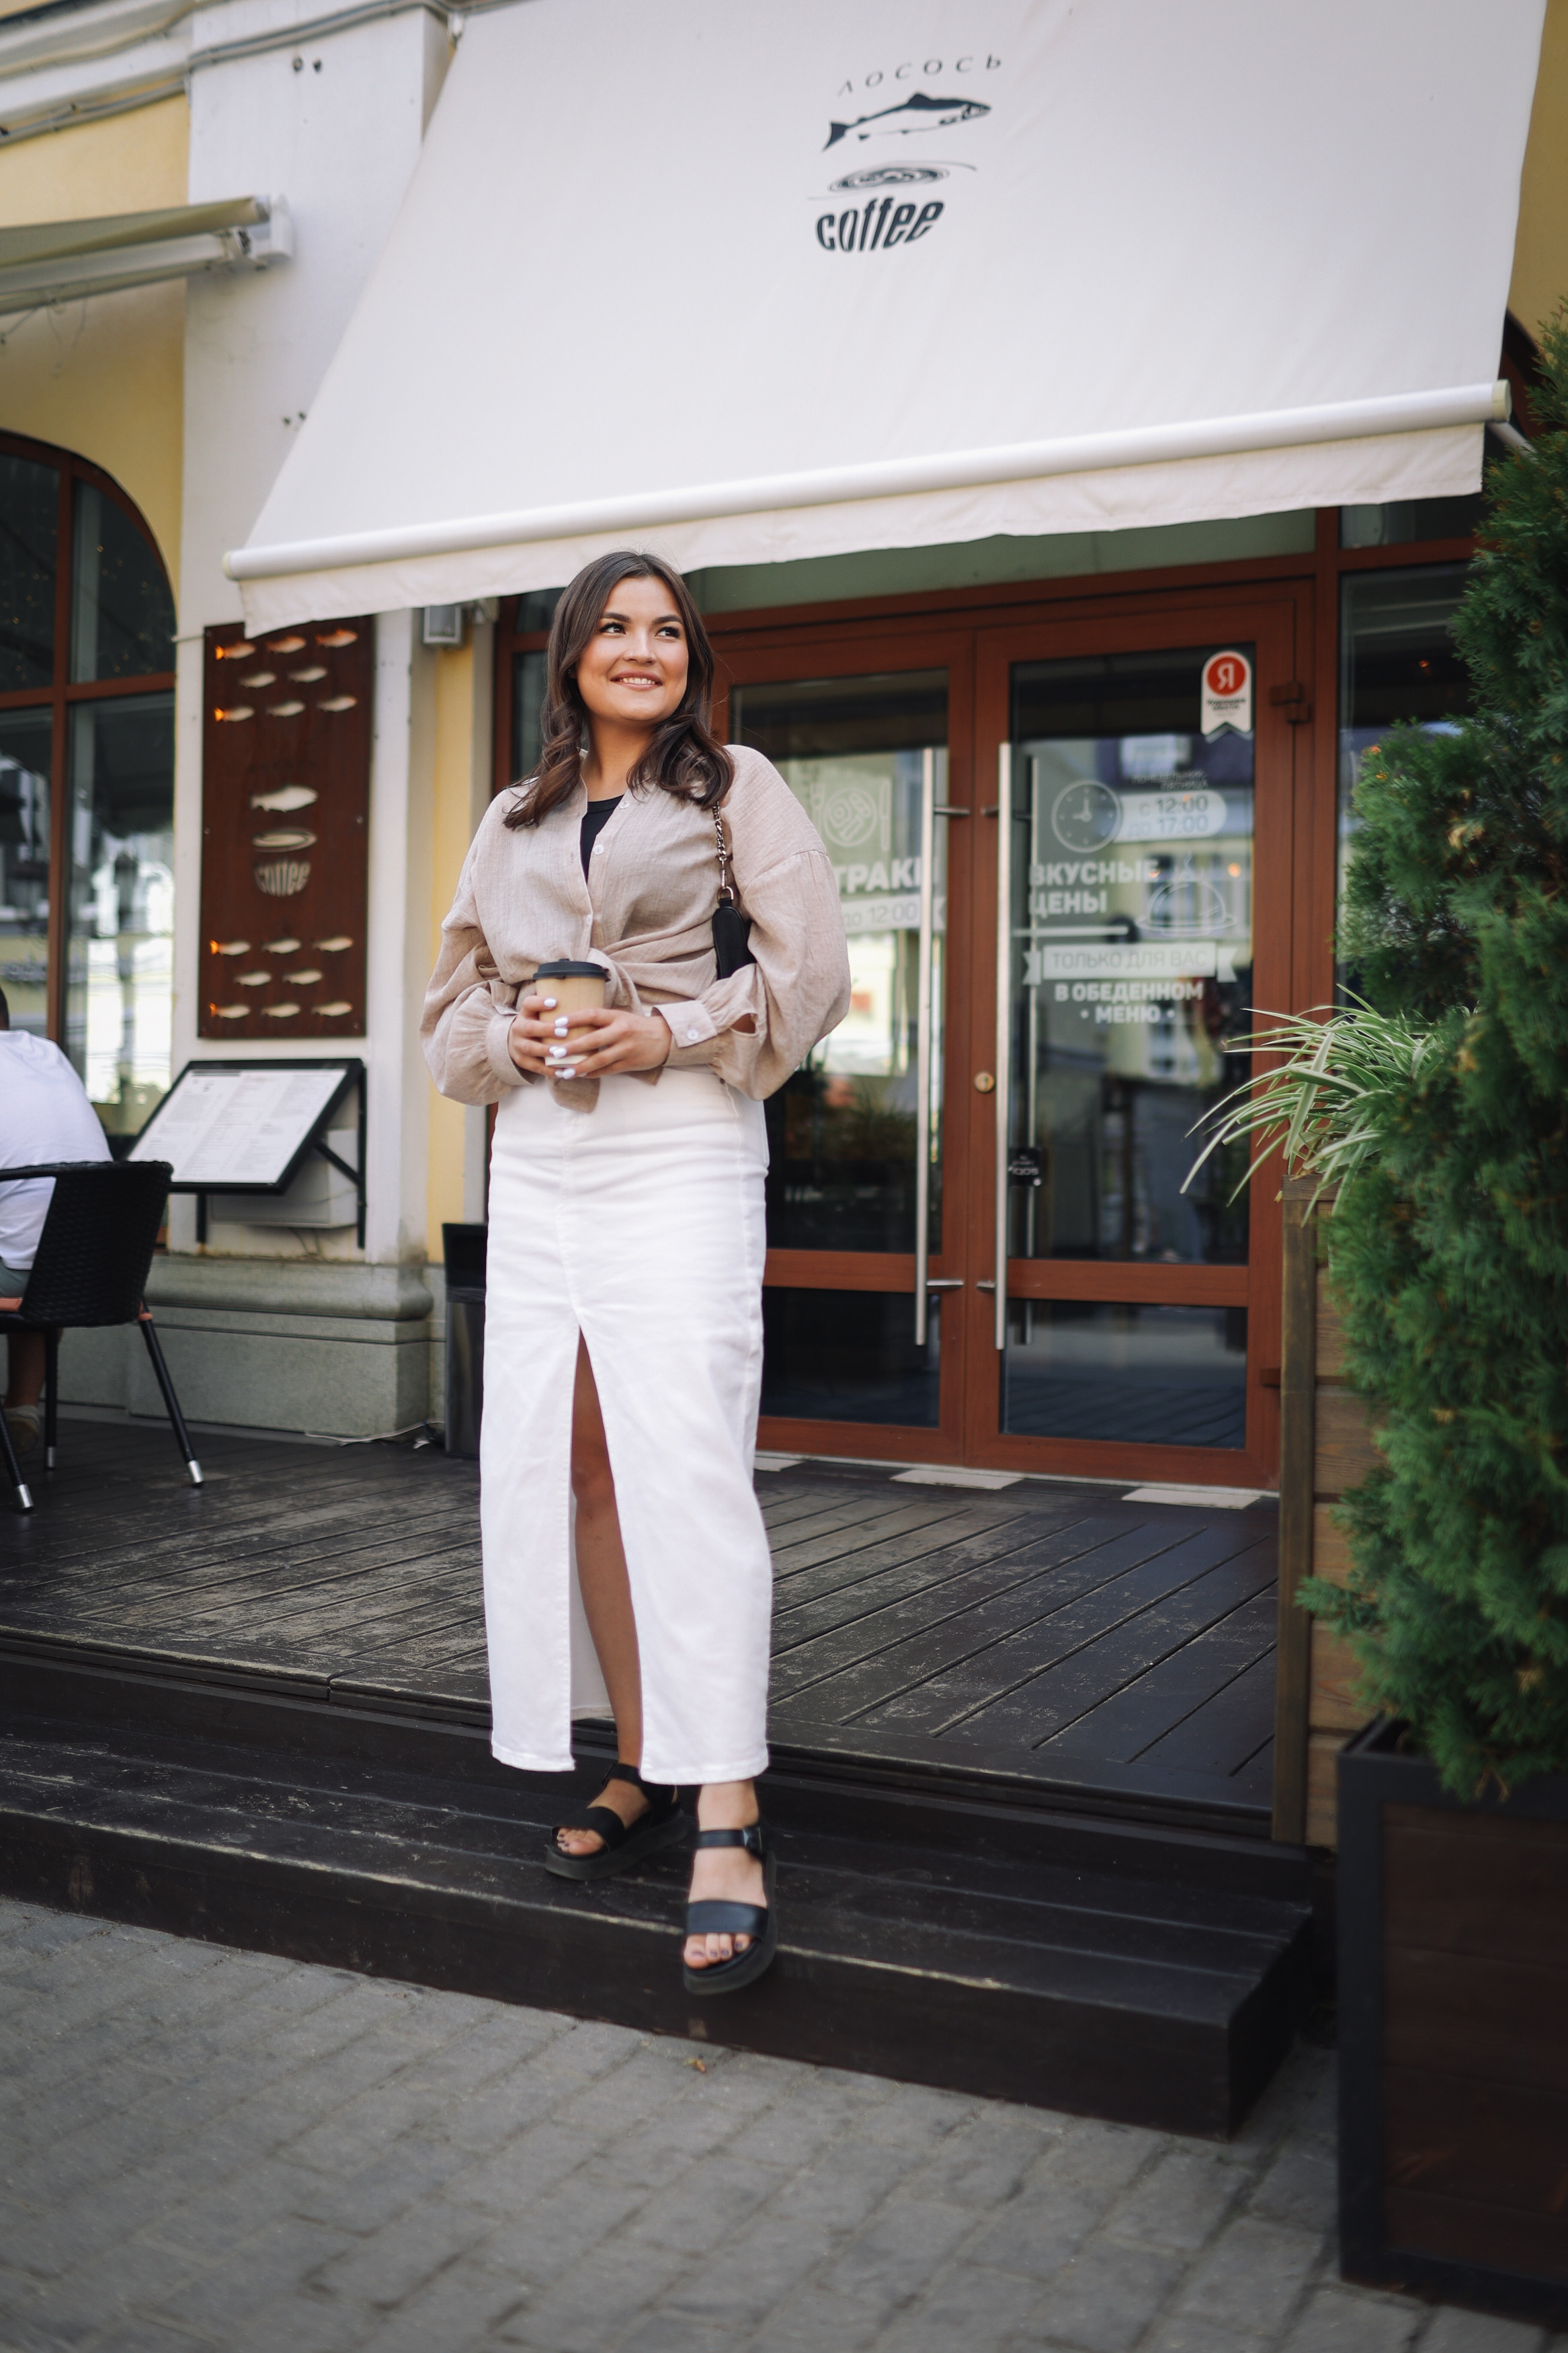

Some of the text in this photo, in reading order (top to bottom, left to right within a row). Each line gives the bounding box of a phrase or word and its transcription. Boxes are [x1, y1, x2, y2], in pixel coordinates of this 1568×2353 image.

[837, 53, 1002, 97] ЛОСОСЬ
[815, 196, 944, 253] coffee
[1216, 662, 1235, 690] Я
[1029, 860, 1159, 886] ВКУСНЫЕ
[1029, 892, 1107, 918] ЦЕНЫ
[1052, 950, 1208, 969] ТОЛЬКО ДЛЯ ВАС
[1055, 981, 1204, 1004] В ОБЕДЕННОМ
[1095, 1005, 1161, 1024] МЕНЮ
